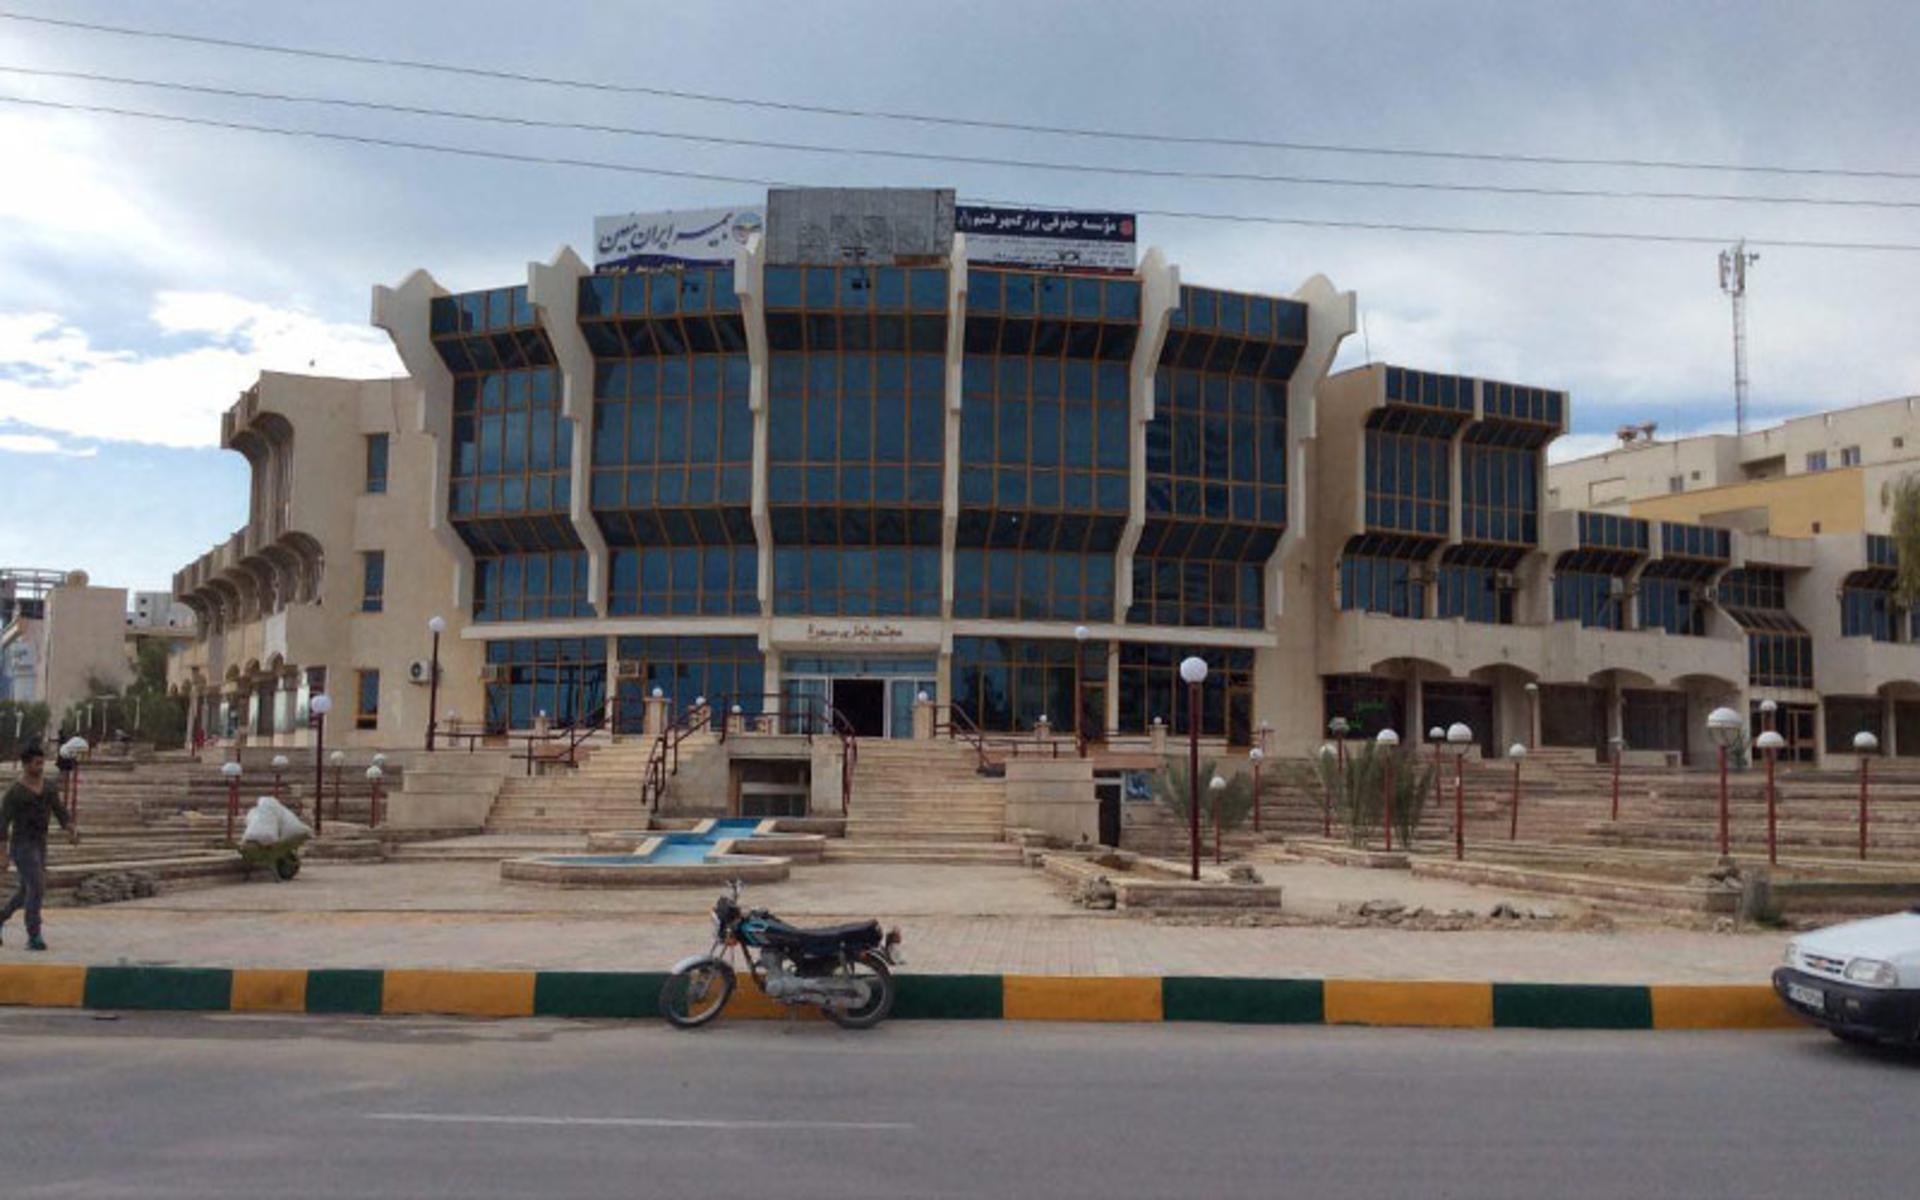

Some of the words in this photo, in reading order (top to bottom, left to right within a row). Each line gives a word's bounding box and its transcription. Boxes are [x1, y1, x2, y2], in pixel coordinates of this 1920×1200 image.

[974, 212, 996, 227] قشم
[1041, 215, 1079, 233] حقوقی
[630, 223, 675, 250] ایران
[673, 212, 733, 247] بیمه
[838, 624, 871, 640] تجاری
[873, 624, 903, 641] مجتمع
